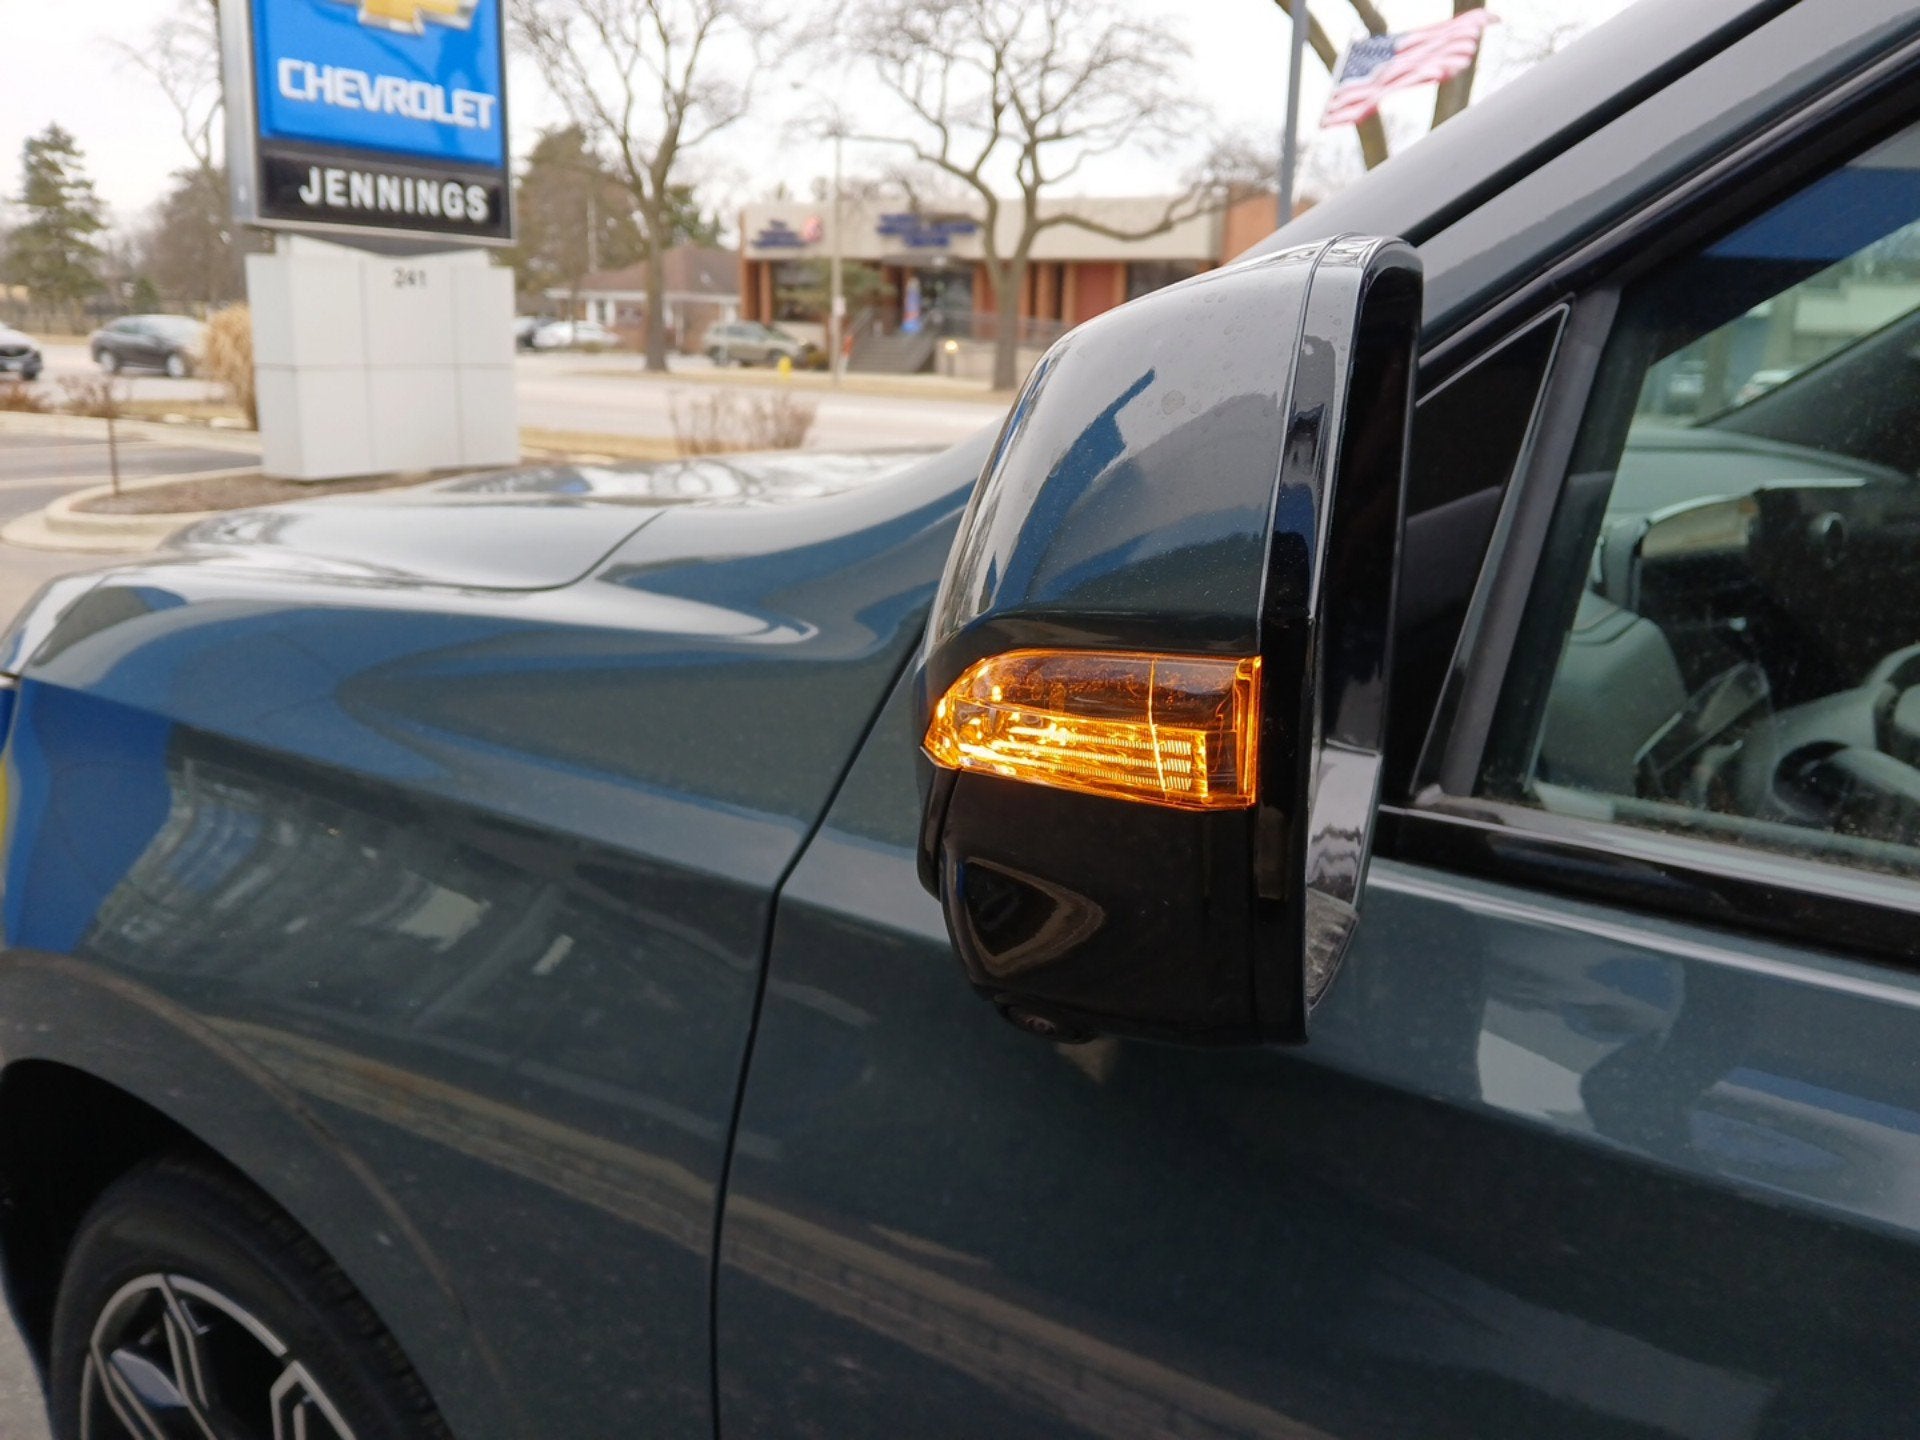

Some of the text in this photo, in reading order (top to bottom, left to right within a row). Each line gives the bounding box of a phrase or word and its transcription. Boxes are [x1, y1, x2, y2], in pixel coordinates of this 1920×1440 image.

[278, 58, 495, 128] CHEVROLET
[299, 167, 489, 222] JENNINGS
[394, 268, 427, 289] 241
